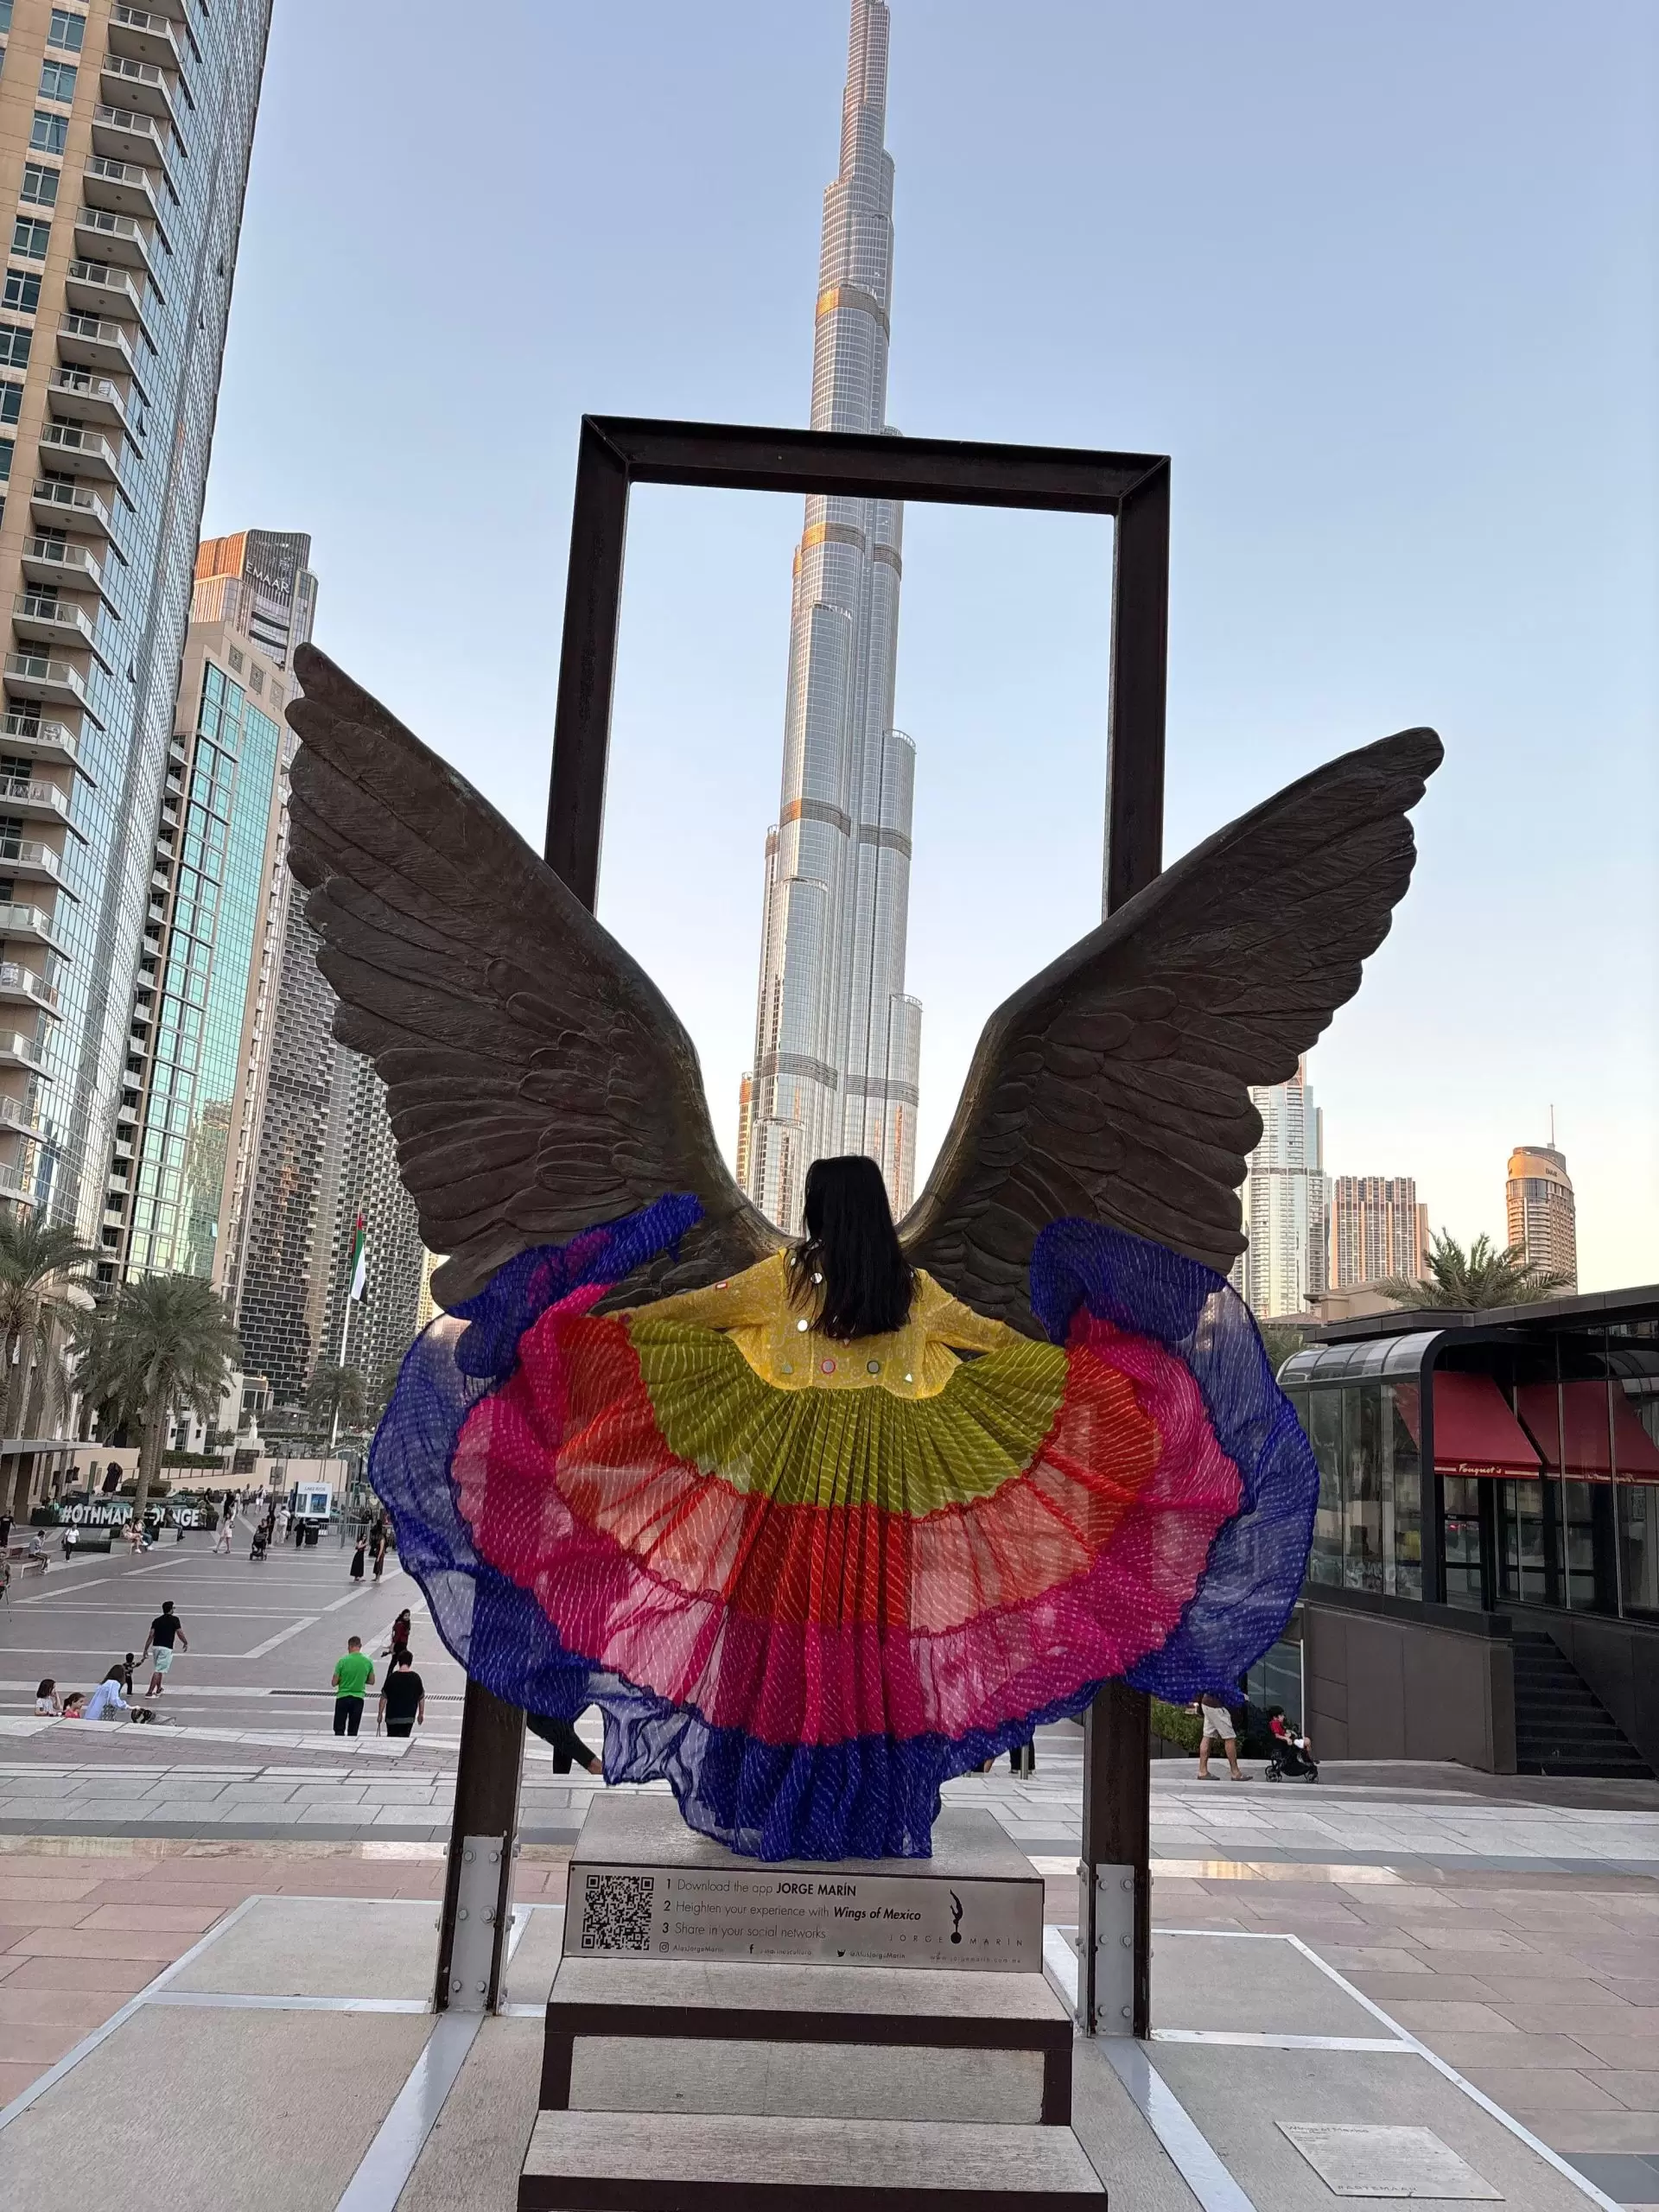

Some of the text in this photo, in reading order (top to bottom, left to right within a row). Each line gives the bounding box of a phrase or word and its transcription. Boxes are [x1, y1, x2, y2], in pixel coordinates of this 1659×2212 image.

[245, 559, 290, 594] EMAAR
[1459, 1463, 1502, 1476] Fouquet's
[60, 1503, 134, 1525] #OTHMAN
[666, 1878, 856, 1897] 1 Download the app JORGE MARÍN
[664, 1901, 921, 1921] 2 Heighten your experience with Wings of Mexico
[662, 1923, 826, 1939] 3 Share in your social networks
[888, 1935, 944, 1943] JORGE
